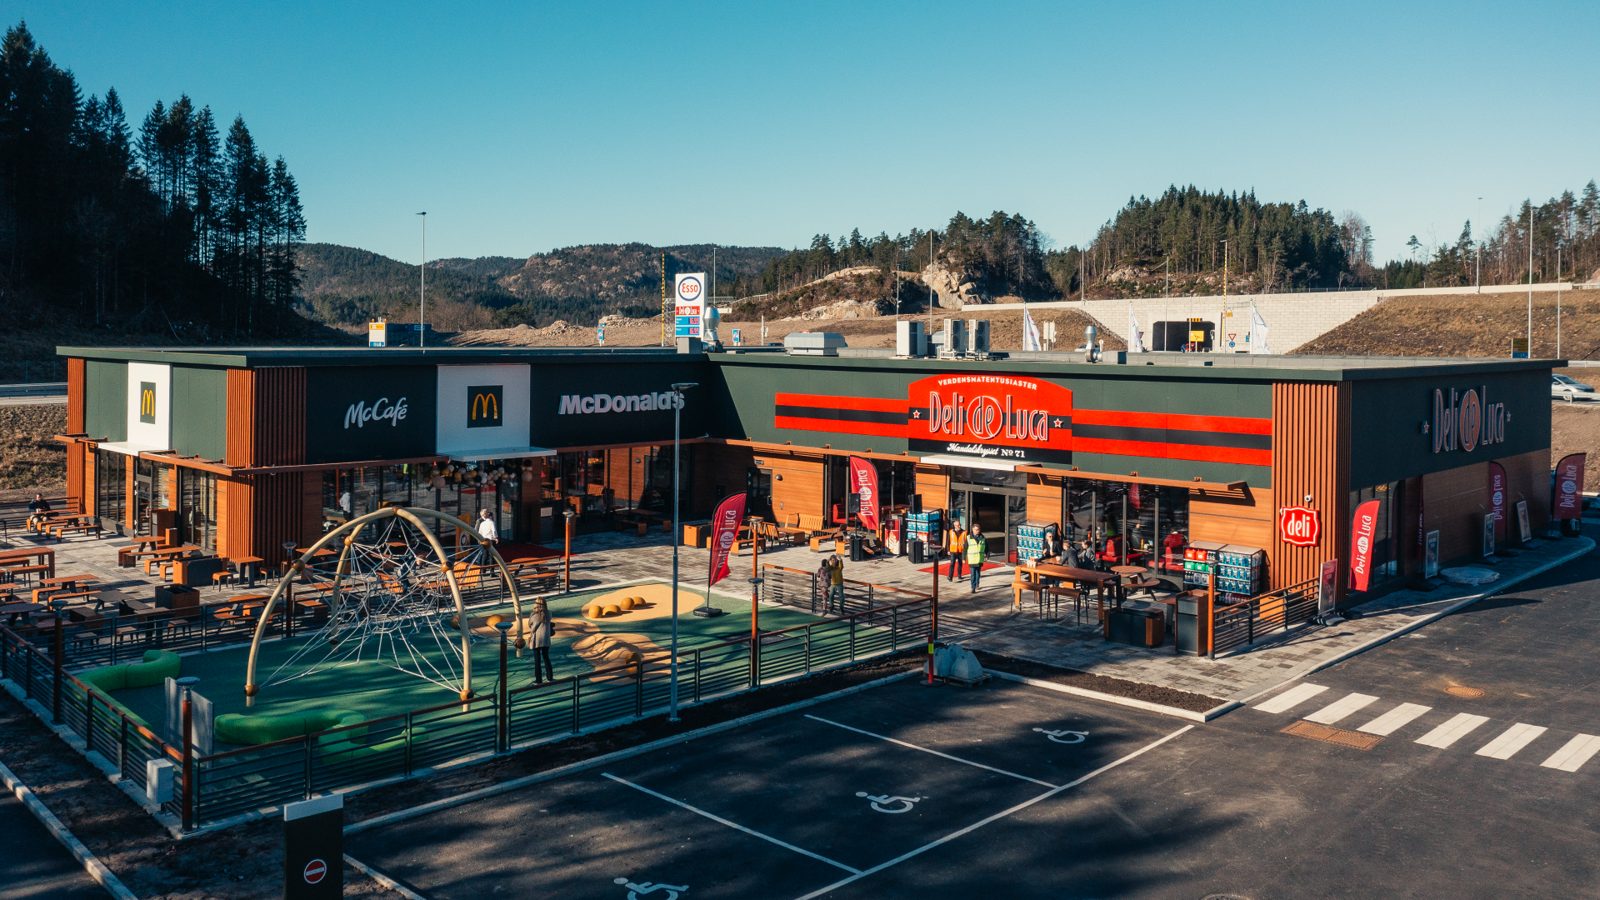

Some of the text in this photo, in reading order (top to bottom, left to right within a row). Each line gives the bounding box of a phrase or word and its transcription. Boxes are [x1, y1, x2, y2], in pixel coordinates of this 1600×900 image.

[938, 376, 1037, 390] VERDENSMATENTUSIASTER
[344, 397, 408, 429] McCafé
[558, 391, 685, 415] McDonald's
[929, 390, 1049, 441] Deli de Luca
[1433, 385, 1505, 453] Deli de Luca
[1014, 450, 1025, 458] 71
[720, 509, 736, 531] Luca
[1287, 512, 1311, 538] deli
[1358, 514, 1372, 537] Luca
[1355, 554, 1366, 575] Deli
